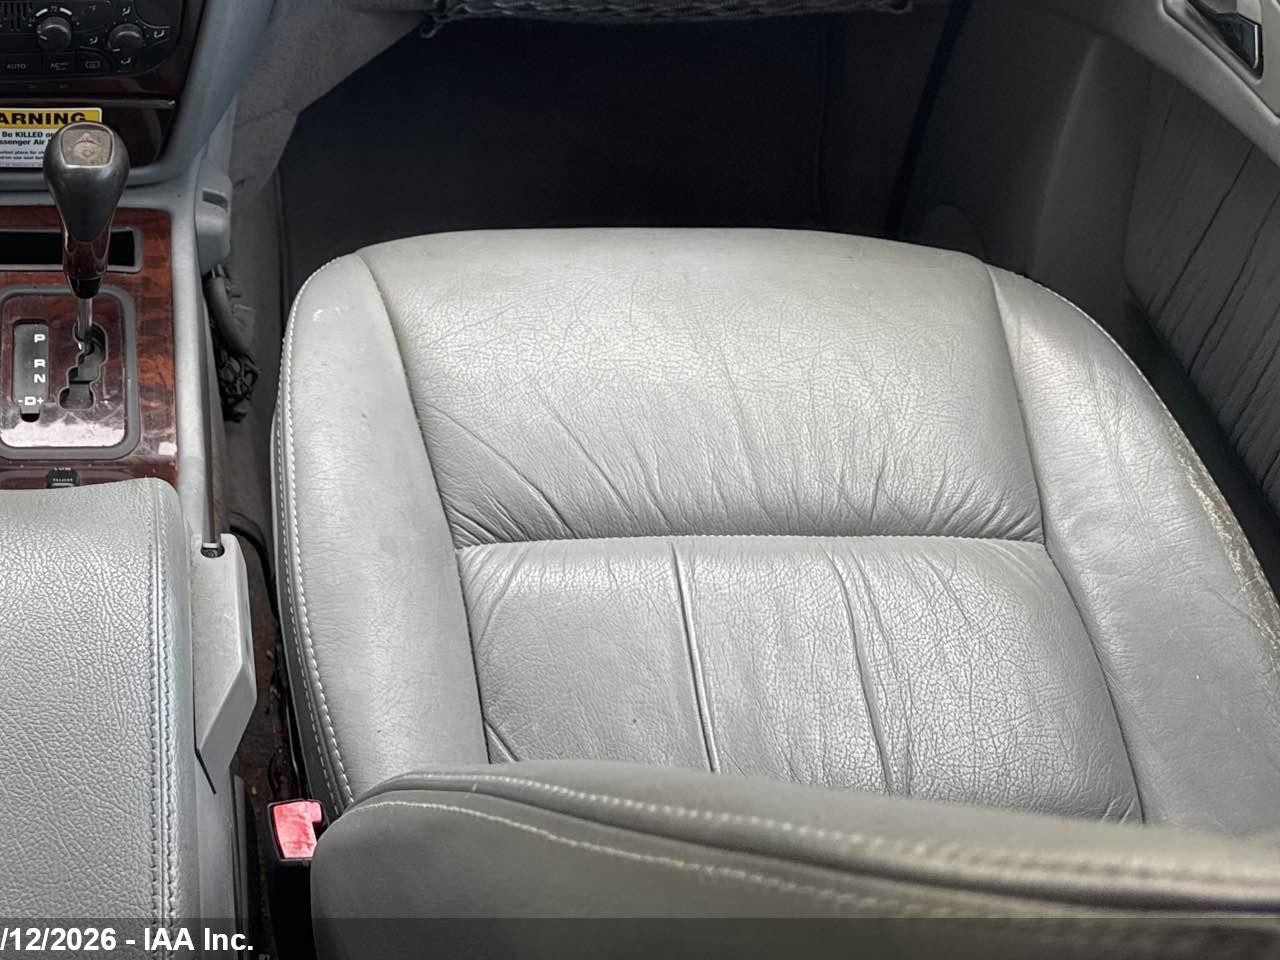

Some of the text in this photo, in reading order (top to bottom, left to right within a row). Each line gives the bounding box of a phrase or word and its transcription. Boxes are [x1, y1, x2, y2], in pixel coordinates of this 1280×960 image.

[33, 333, 46, 343] P
[33, 358, 46, 368] R
[33, 373, 46, 384] N
